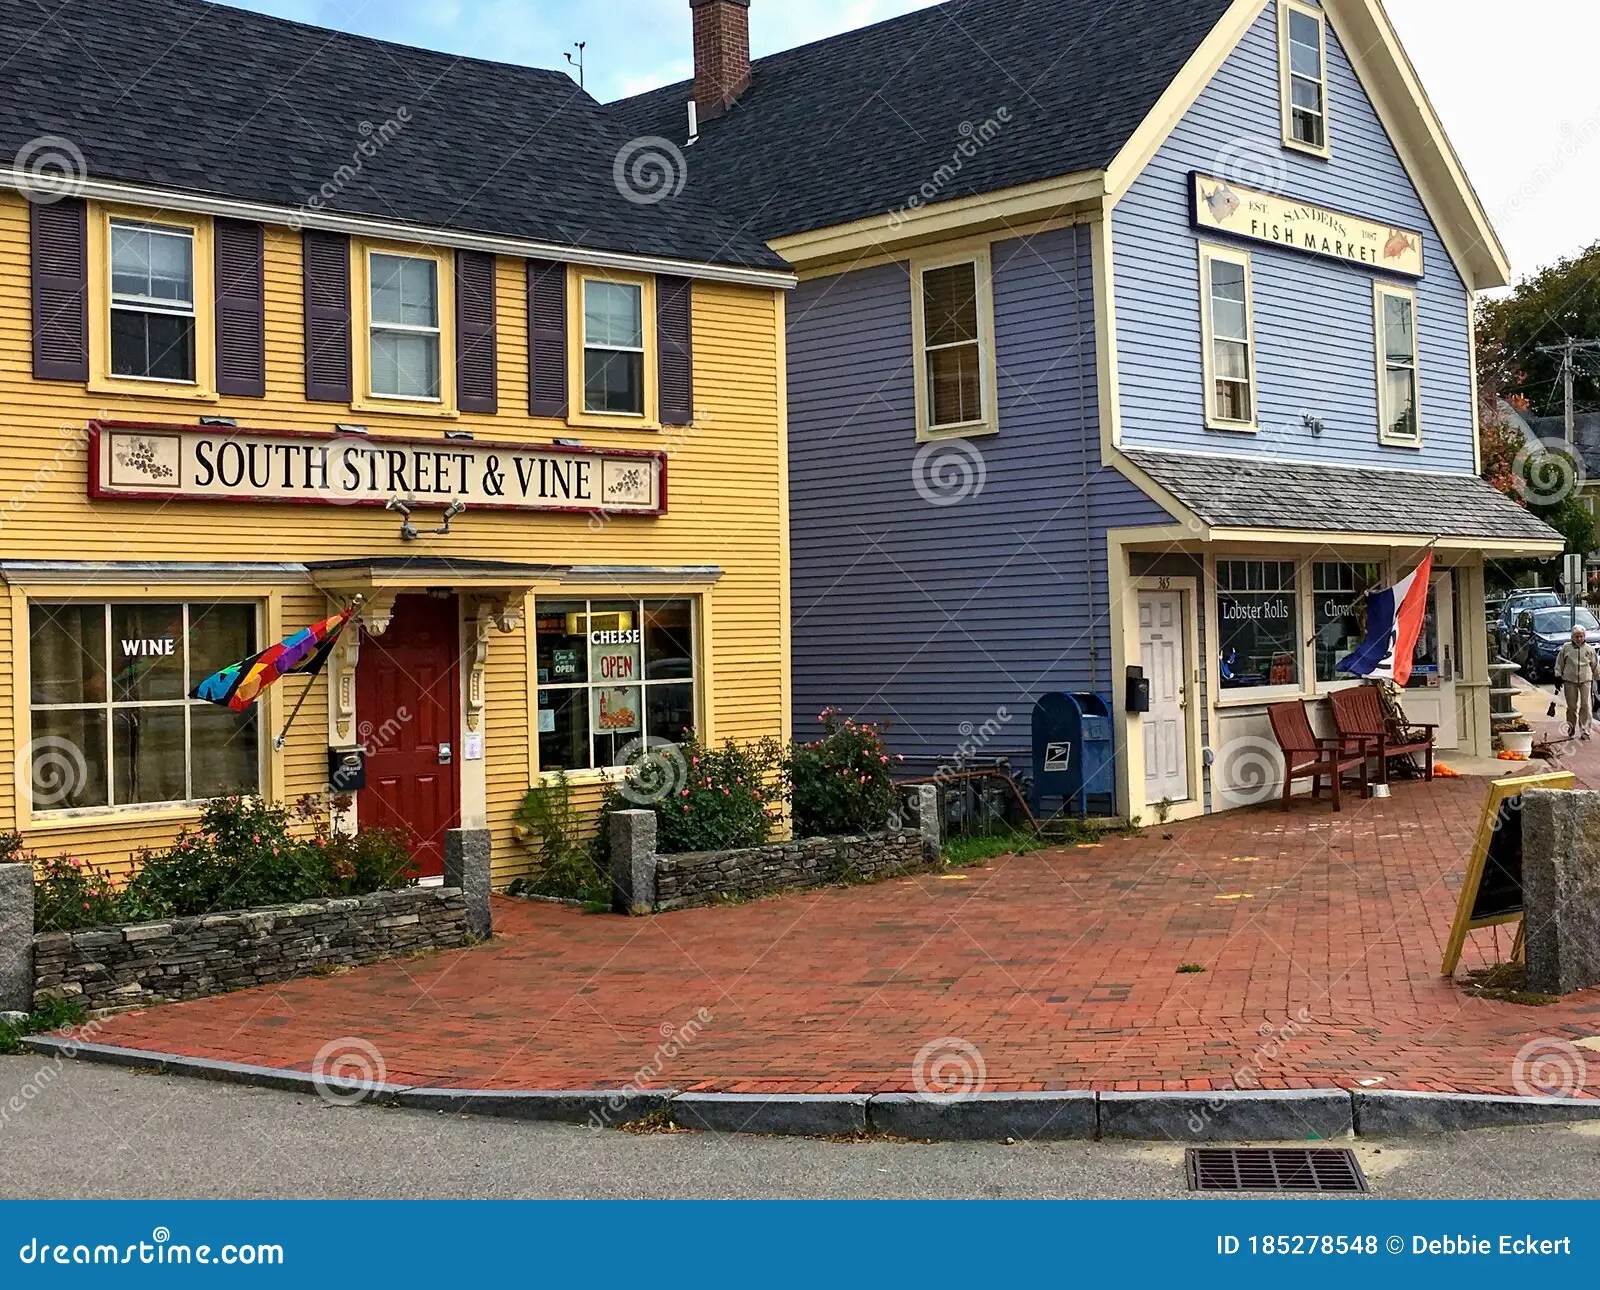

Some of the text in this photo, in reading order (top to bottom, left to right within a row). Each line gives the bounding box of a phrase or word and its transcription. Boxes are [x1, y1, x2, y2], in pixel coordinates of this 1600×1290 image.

[1283, 207, 1346, 237] SANDERS
[1251, 219, 1377, 263] FISH MARKET
[195, 440, 591, 500] SOUTH STREET & VINE
[1158, 576, 1170, 590] 365
[1223, 599, 1289, 619] Lobster Rolls
[591, 628, 640, 645] CHEESE
[121, 639, 175, 656] WINE
[555, 664, 576, 674] OPEN
[600, 655, 633, 678] OPEN
